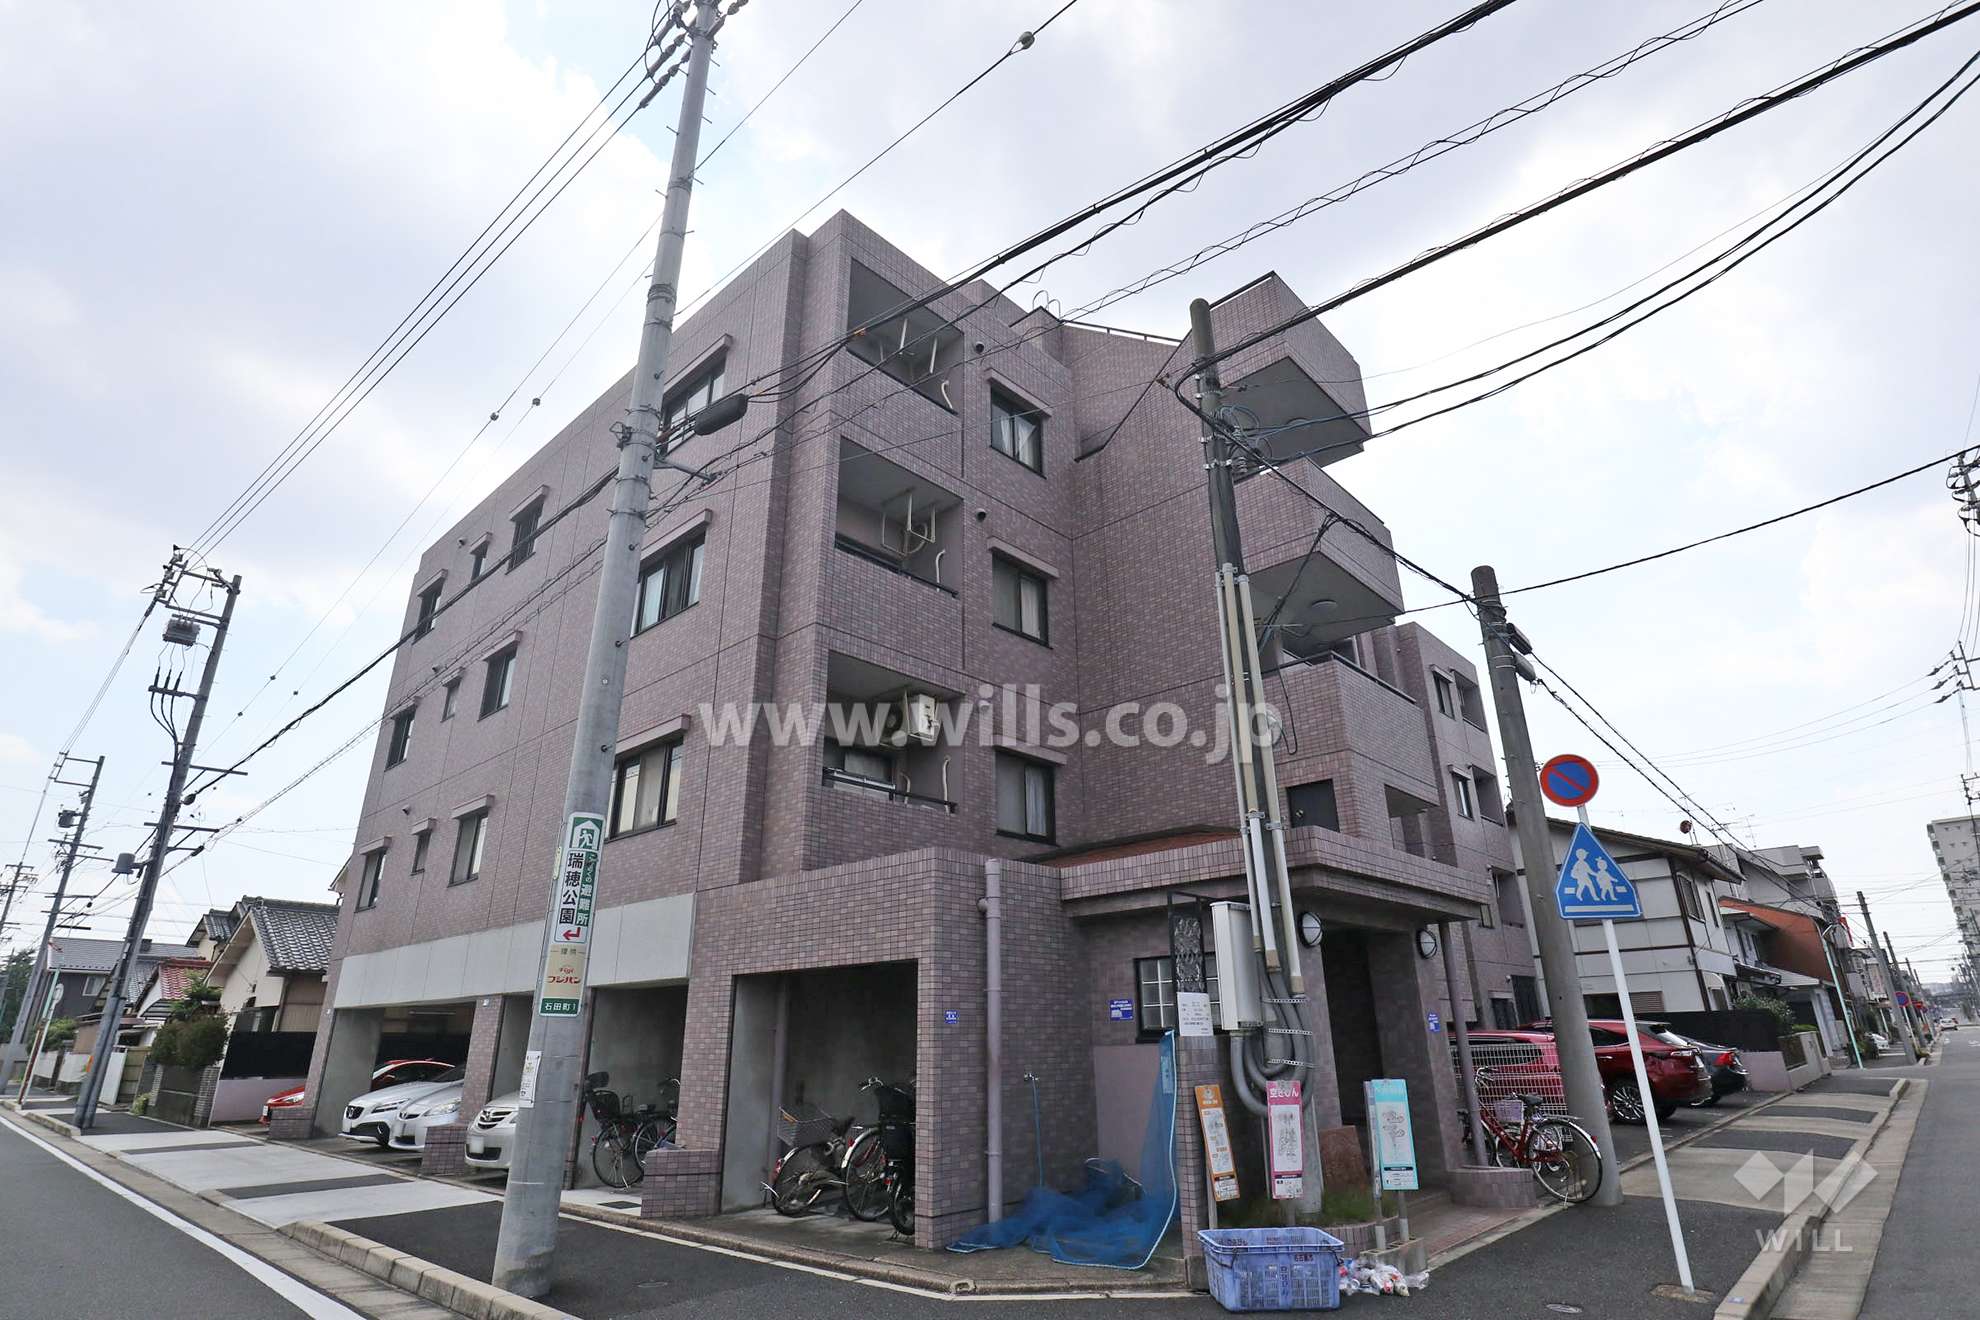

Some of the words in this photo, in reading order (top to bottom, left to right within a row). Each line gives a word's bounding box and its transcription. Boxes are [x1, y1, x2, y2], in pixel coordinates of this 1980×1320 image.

[559, 852, 584, 925] 瑞穂公園
[547, 975, 581, 984] フジパン
